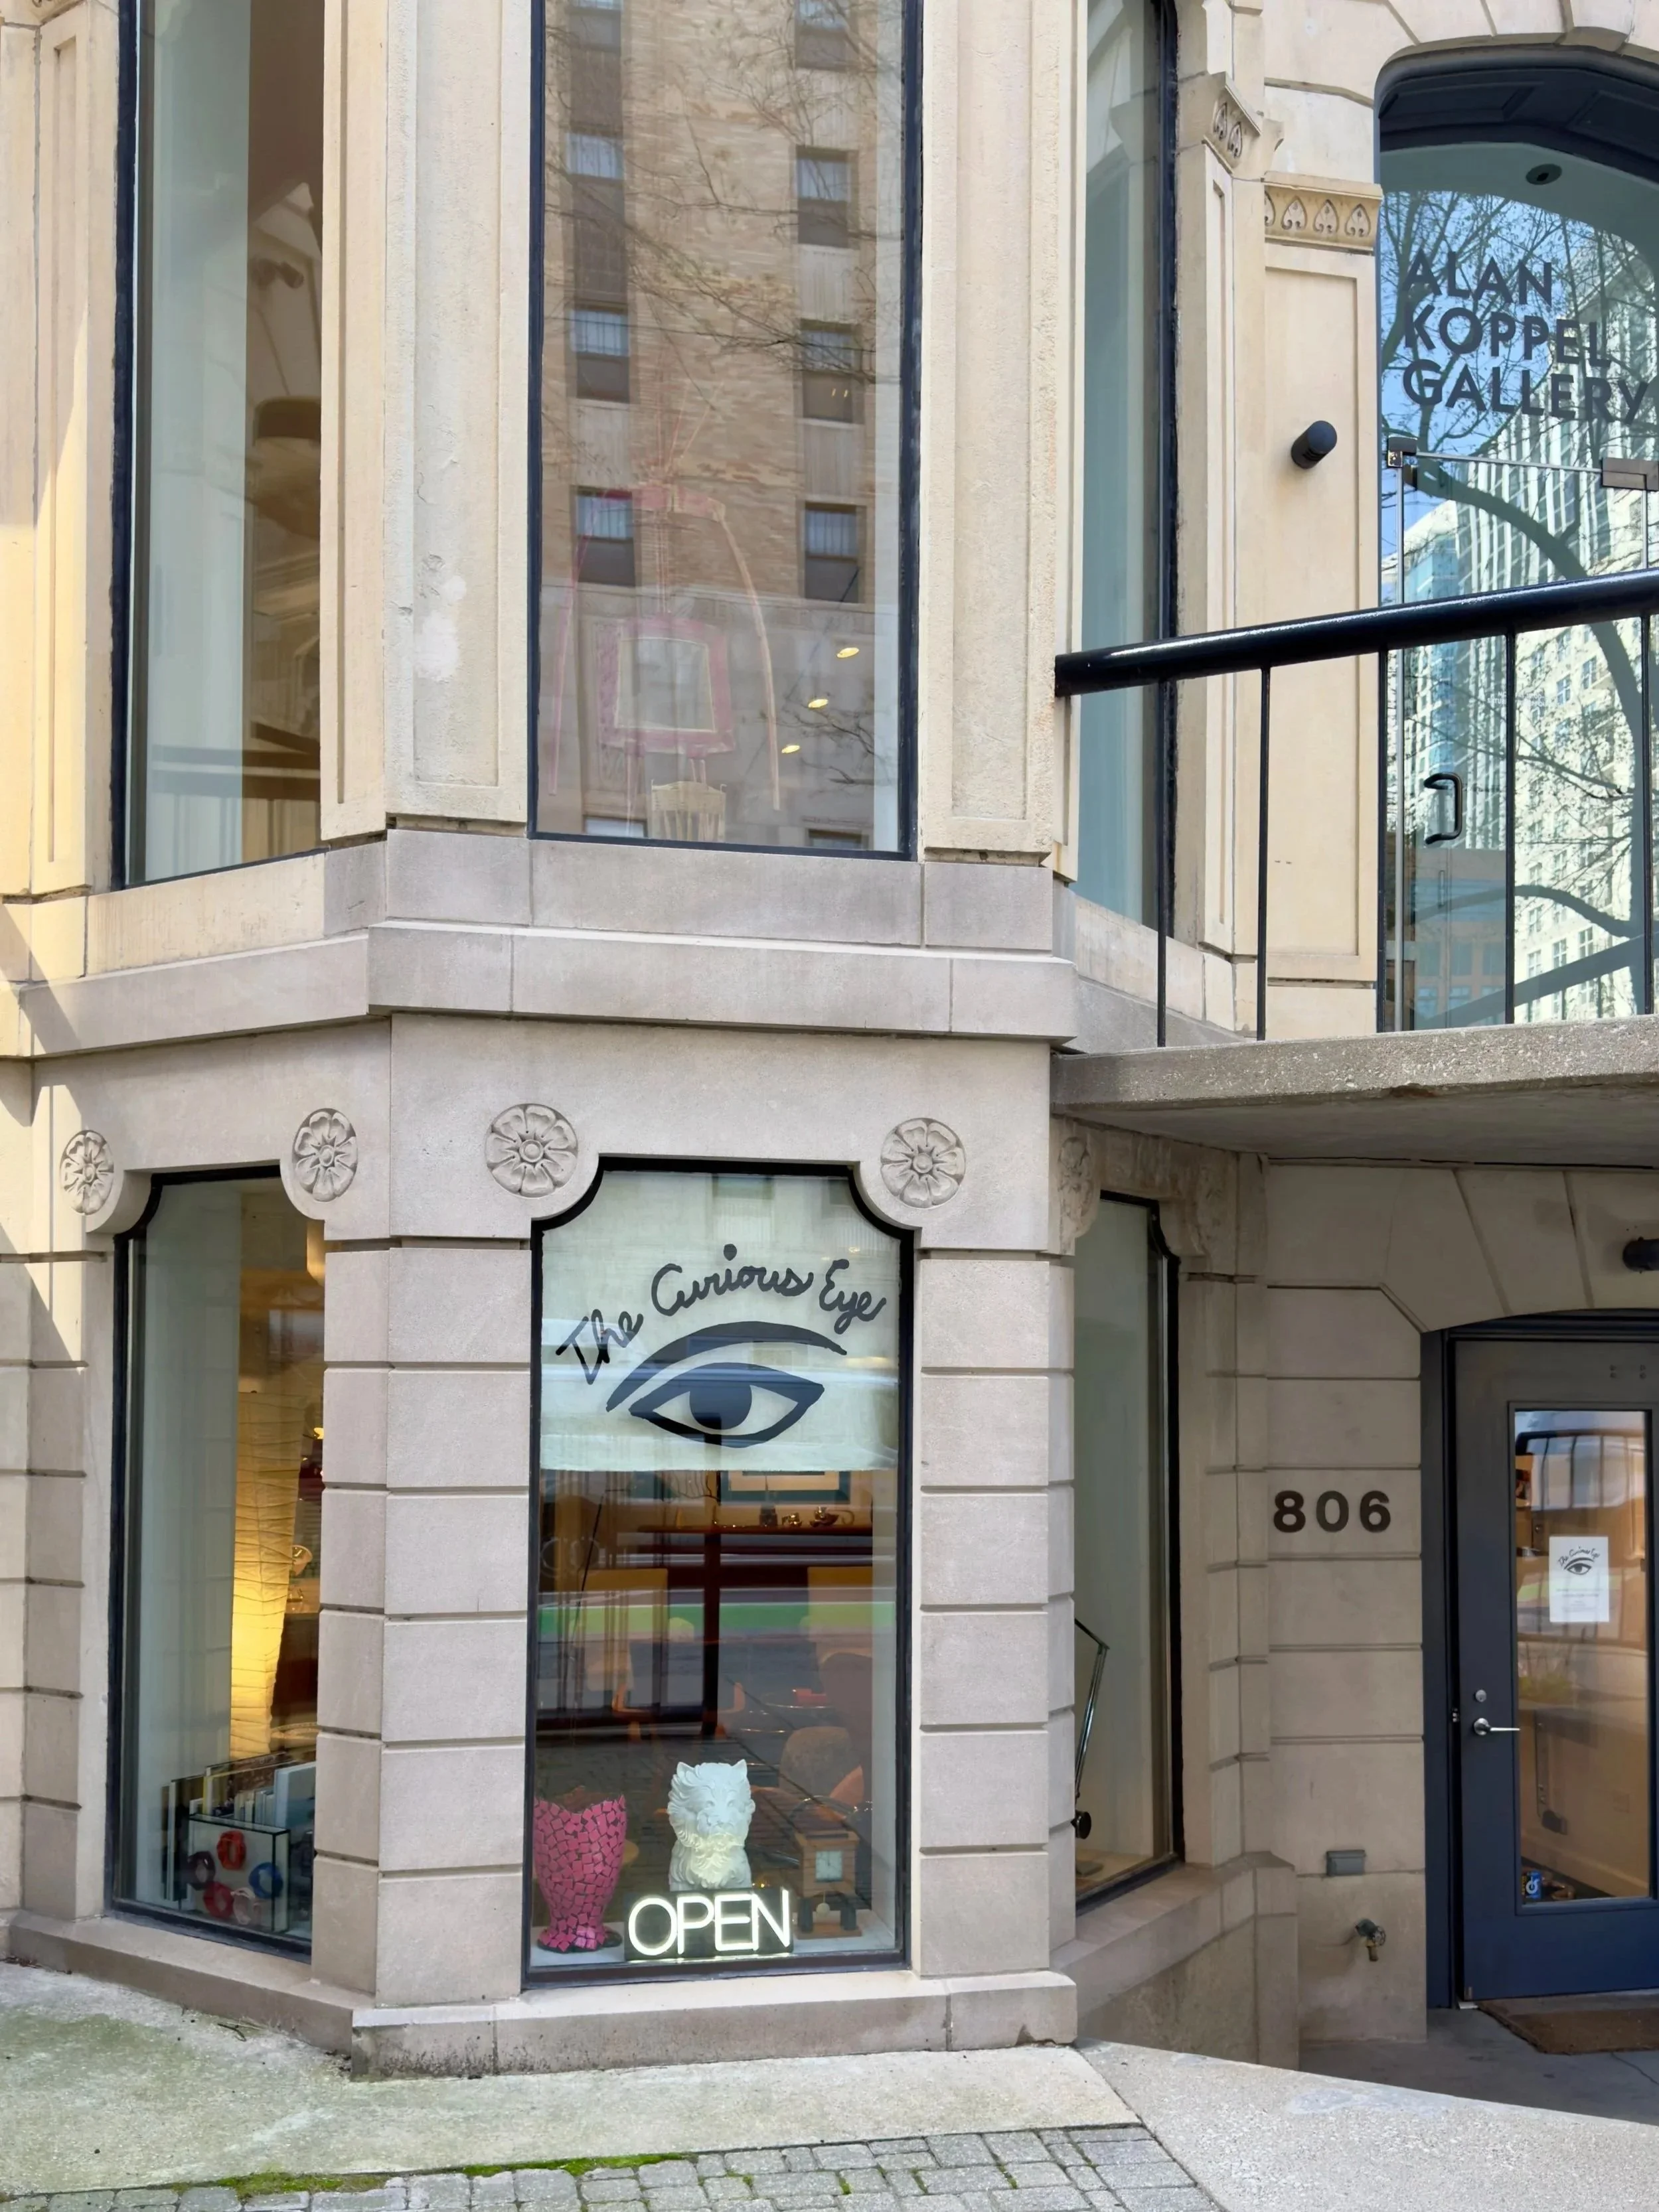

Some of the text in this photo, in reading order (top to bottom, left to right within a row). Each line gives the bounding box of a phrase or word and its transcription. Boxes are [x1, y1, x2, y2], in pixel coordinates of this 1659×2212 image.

[1401, 248, 1552, 306] ALAN
[1404, 303, 1611, 368] KOPPEL
[1403, 359, 1649, 425] GALLERY
[556, 1243, 887, 1385] The Curious Eye
[1273, 1490, 1391, 1533] 806
[627, 1888, 791, 1956] OPEN
